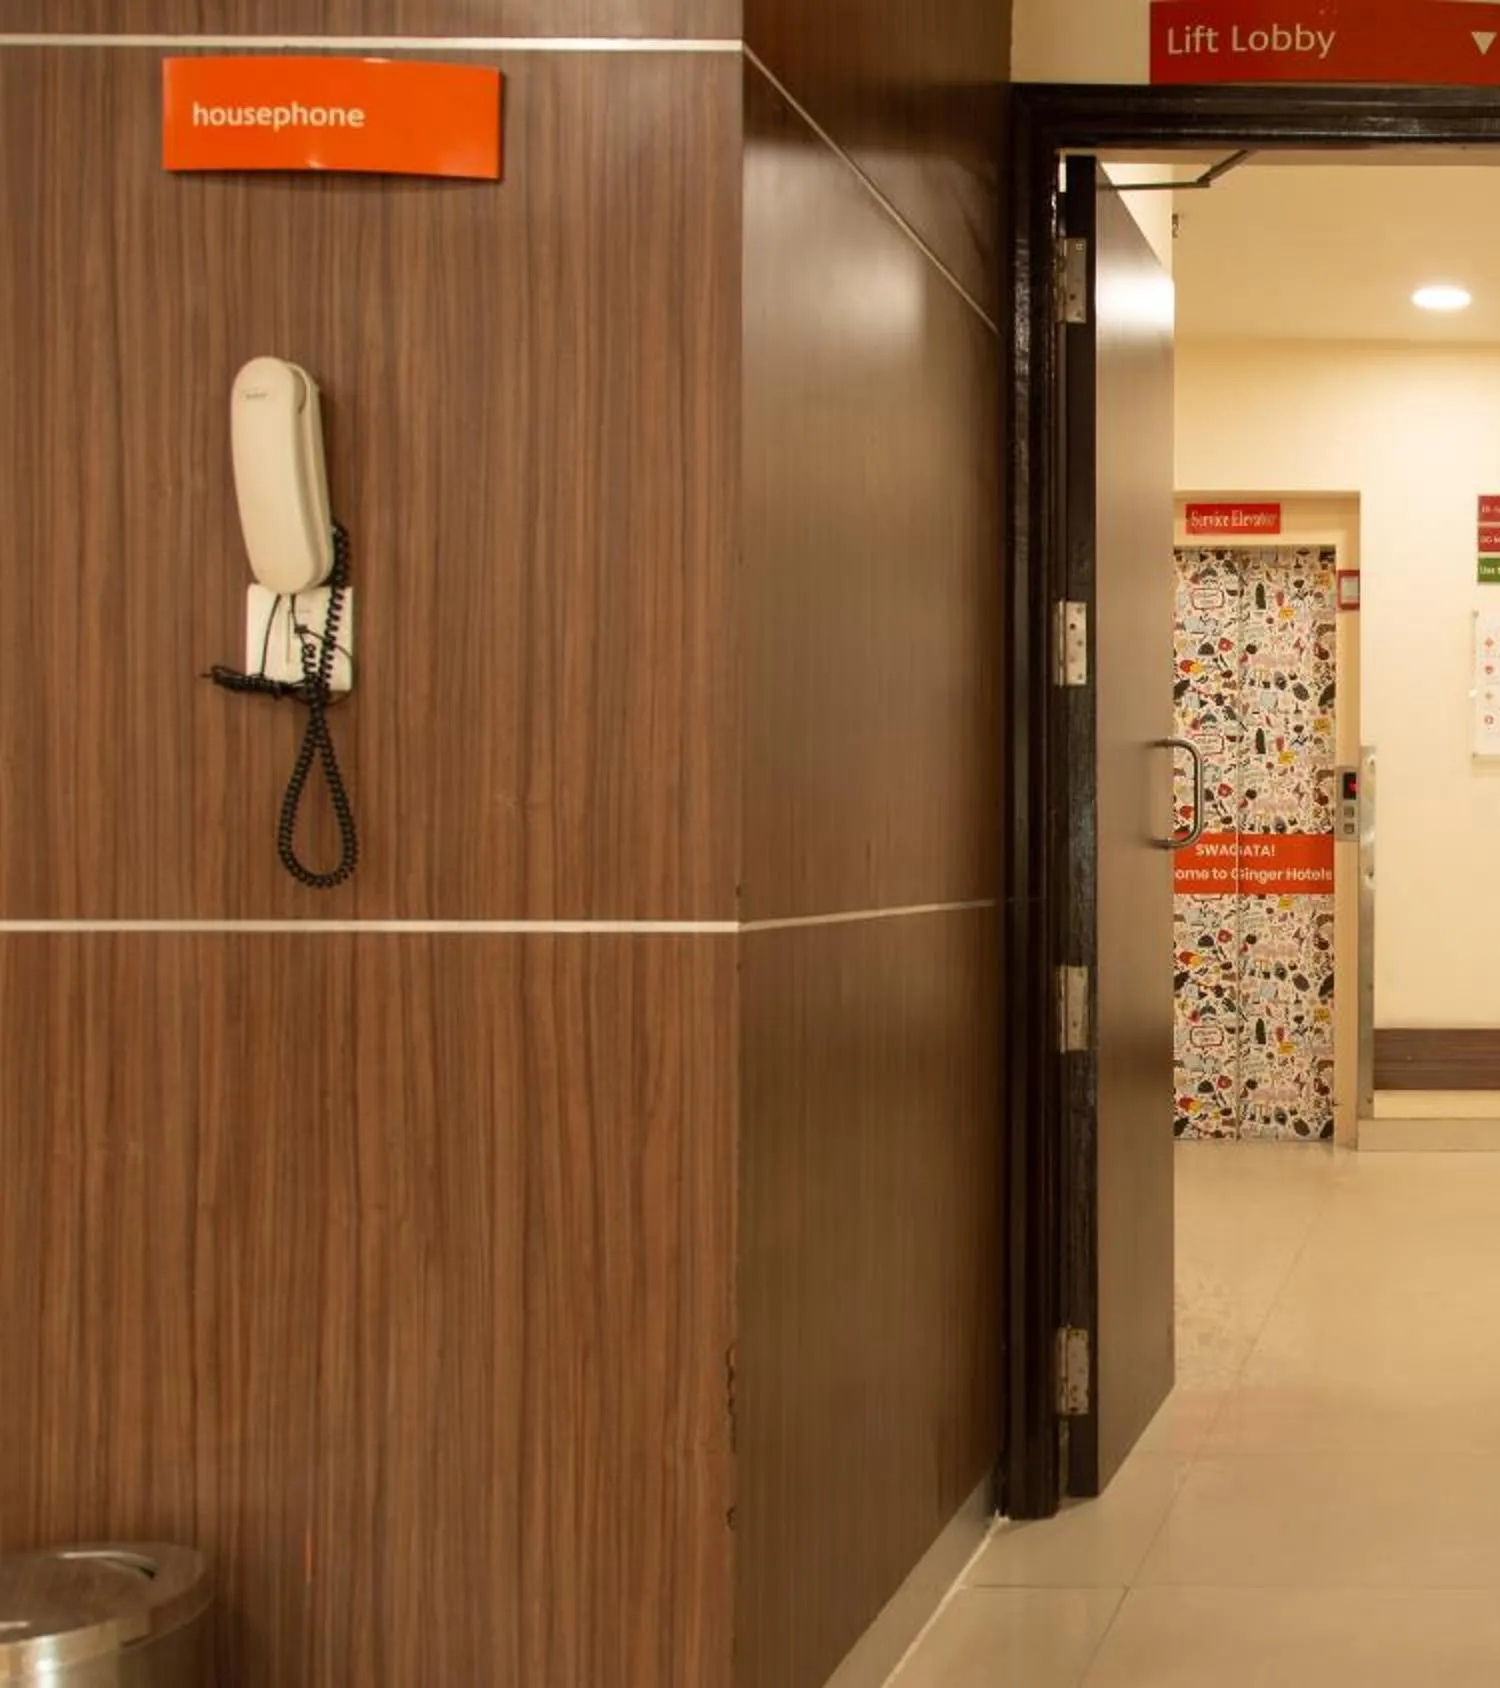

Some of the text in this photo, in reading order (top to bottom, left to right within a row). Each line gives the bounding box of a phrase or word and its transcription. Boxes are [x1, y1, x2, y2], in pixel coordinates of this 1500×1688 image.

[1168, 24, 1336, 59] Lift Lobby
[193, 101, 366, 132] housephone
[1191, 511, 1228, 527] Service
[1212, 868, 1227, 880] to
[1231, 867, 1282, 884] Ginger
[1286, 867, 1332, 880] Hotels
